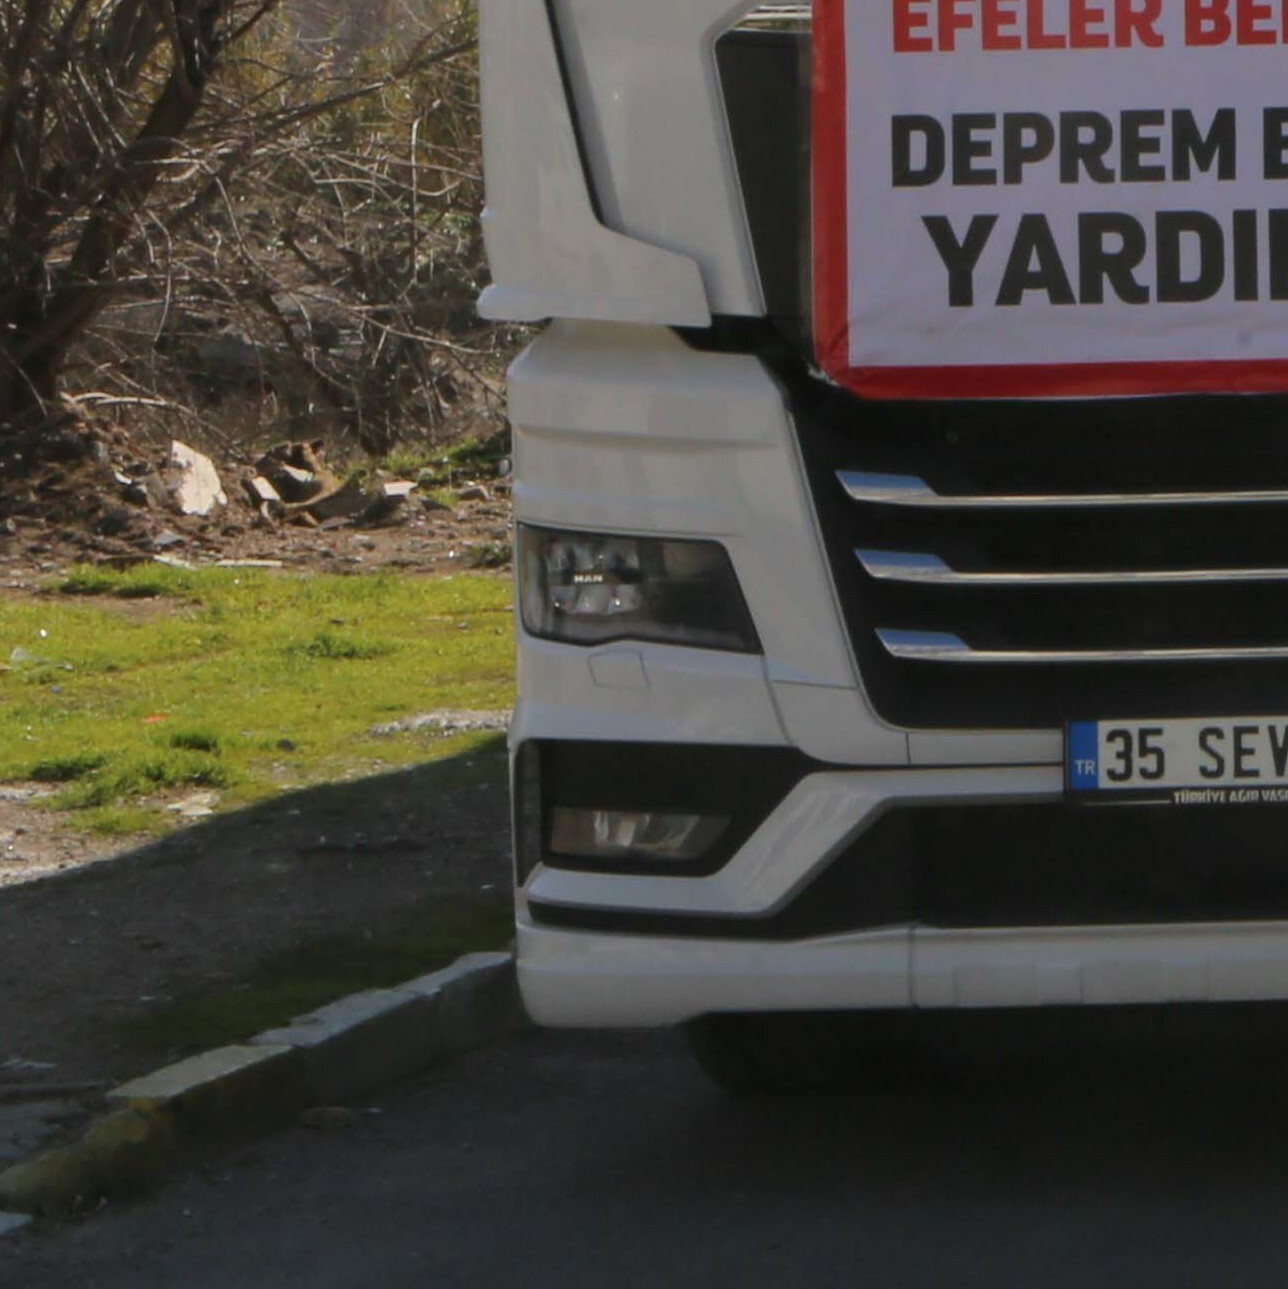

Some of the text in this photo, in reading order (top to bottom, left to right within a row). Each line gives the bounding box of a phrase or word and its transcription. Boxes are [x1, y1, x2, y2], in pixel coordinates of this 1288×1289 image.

[891, 108, 1236, 187] DEPREM
[1075, 760, 1096, 776] TR
[1106, 728, 1164, 782] 35
